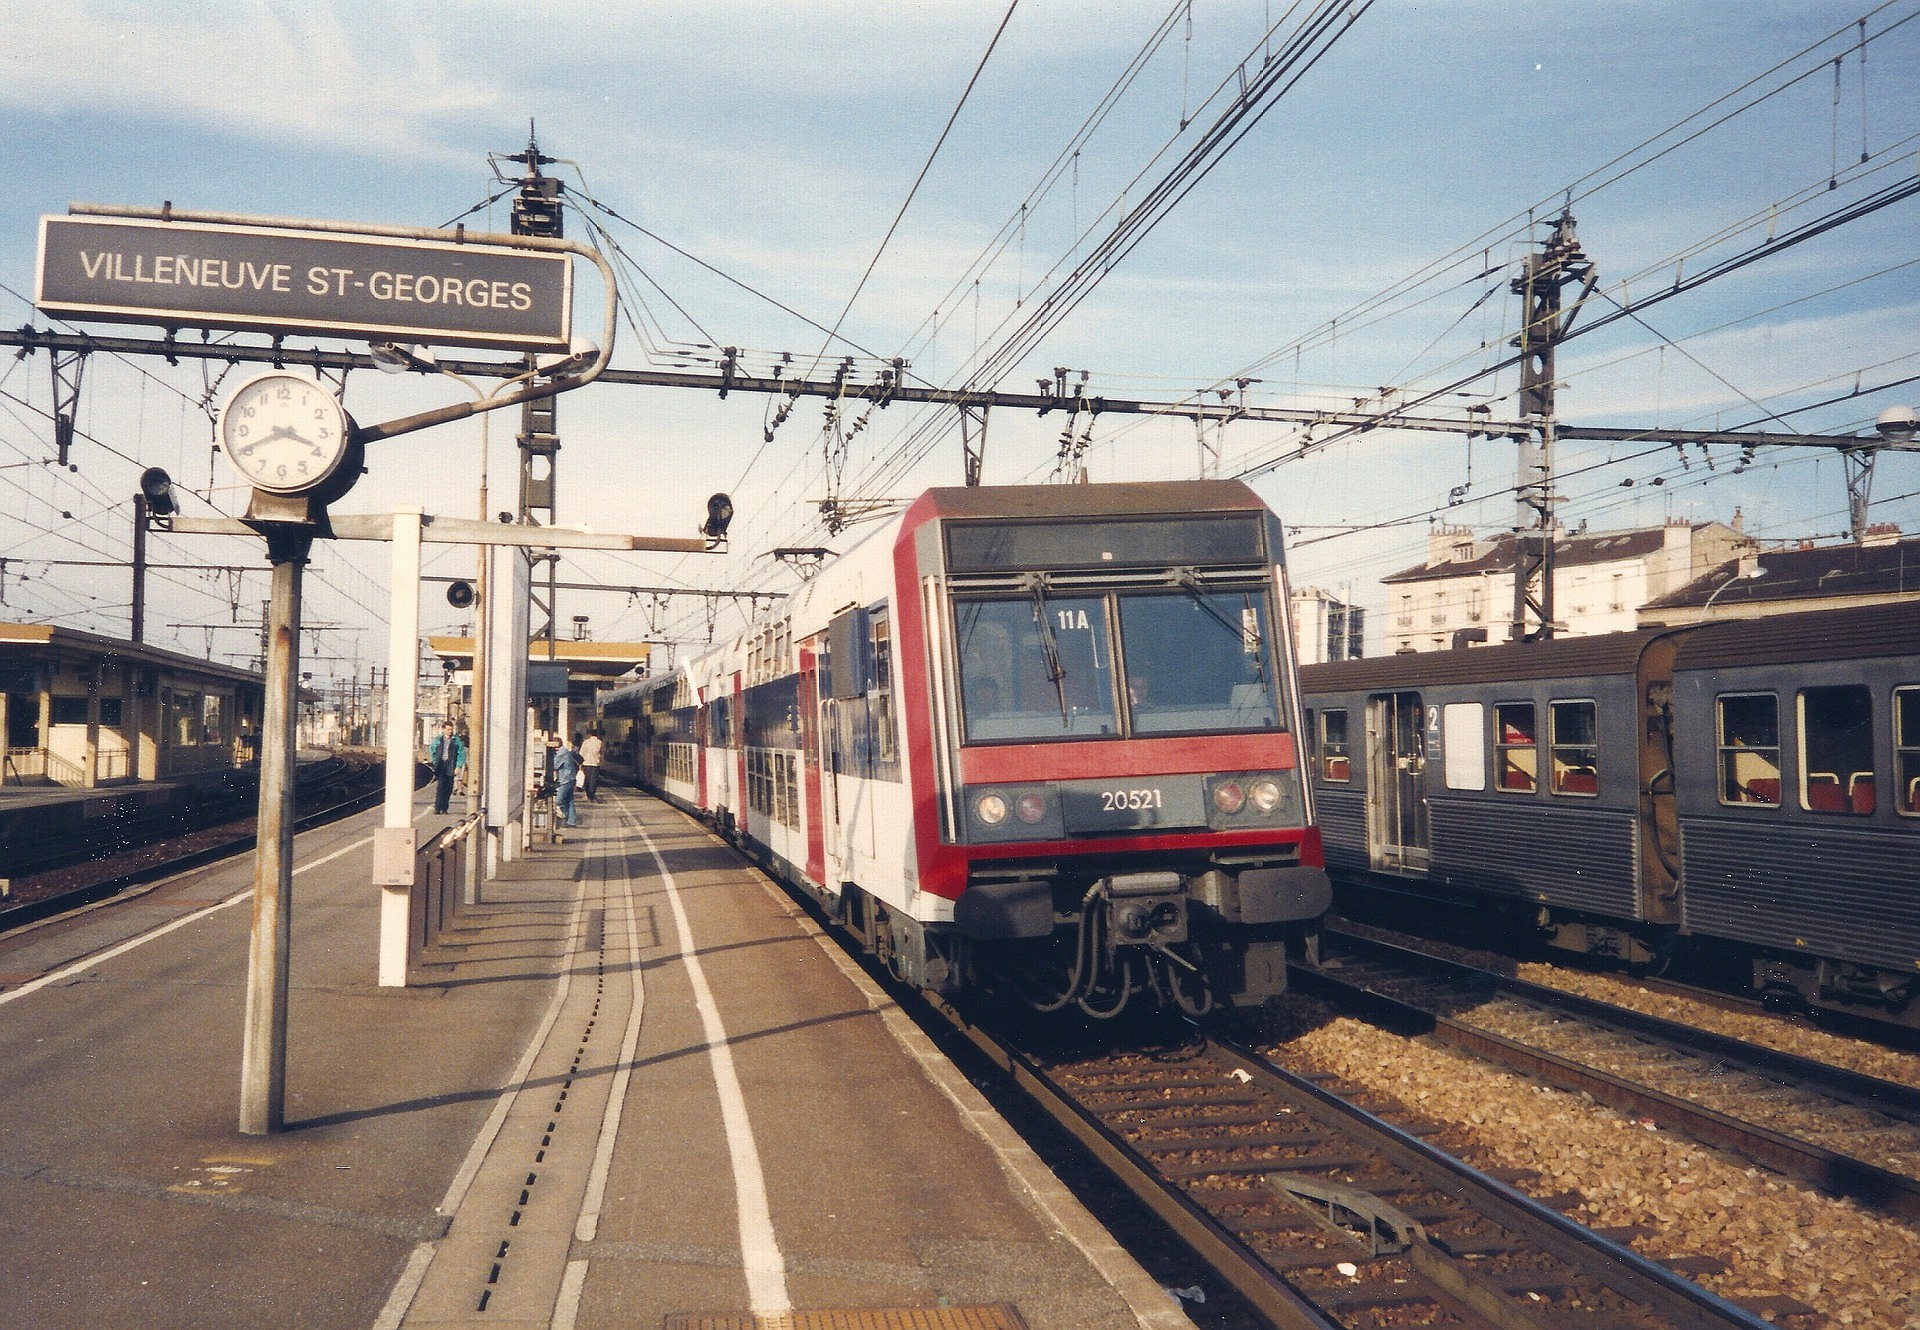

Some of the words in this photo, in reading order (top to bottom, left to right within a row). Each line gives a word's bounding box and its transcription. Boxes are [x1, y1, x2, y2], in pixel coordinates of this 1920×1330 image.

[80, 251, 292, 292] VILLENEUVE
[306, 266, 532, 311] ST-GEORGES
[277, 388, 291, 400] 12
[243, 407, 255, 418] 10
[314, 408, 325, 420] 2
[239, 425, 249, 437] 9
[319, 428, 328, 439] 3
[257, 460, 266, 472] 7
[277, 465, 287, 477] 6
[297, 461, 308, 473] 5
[1429, 707, 1438, 730] 2
[1101, 789, 1162, 811] 20521
